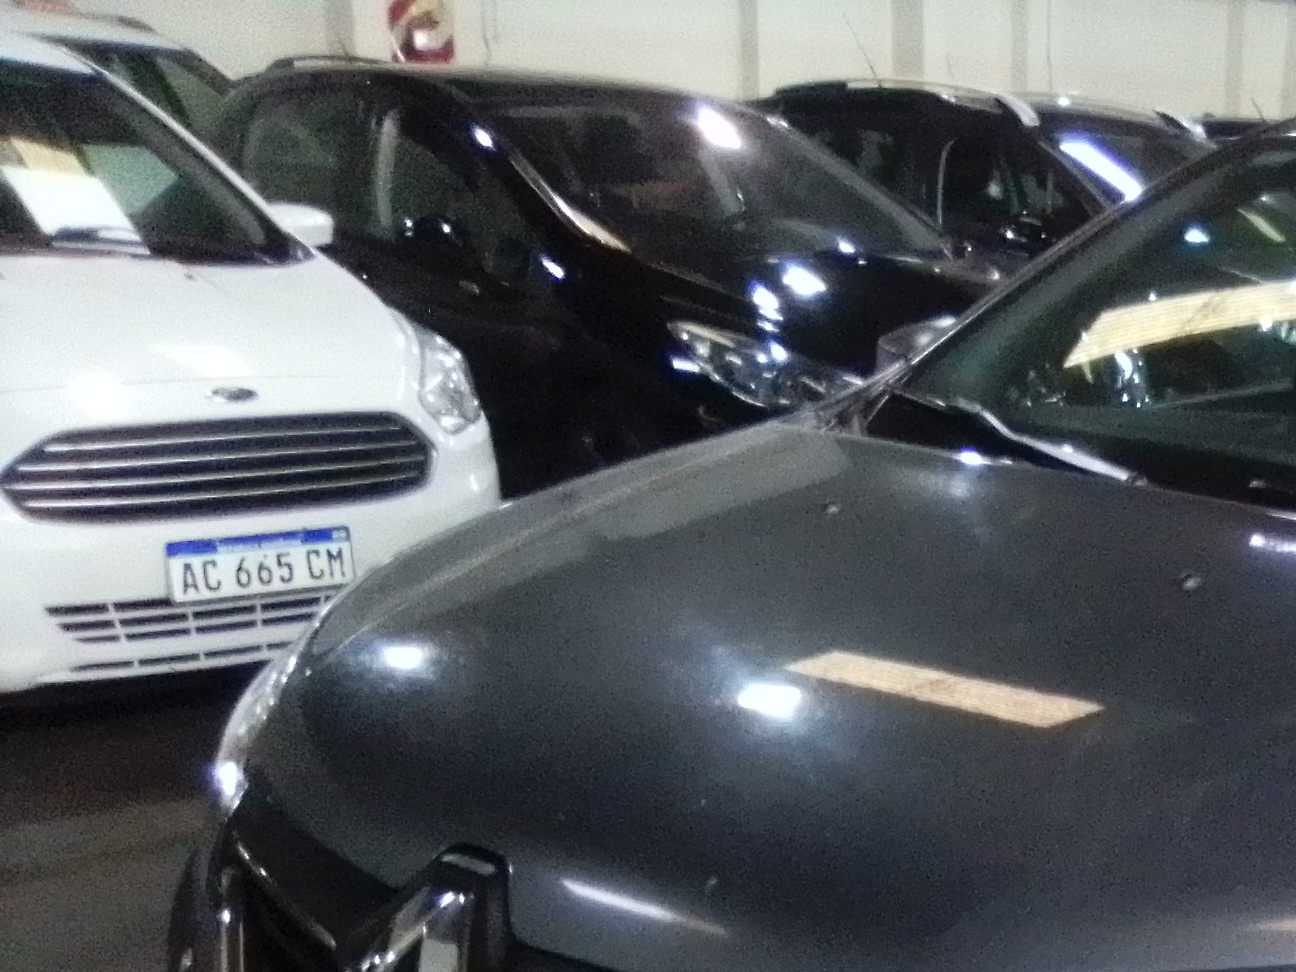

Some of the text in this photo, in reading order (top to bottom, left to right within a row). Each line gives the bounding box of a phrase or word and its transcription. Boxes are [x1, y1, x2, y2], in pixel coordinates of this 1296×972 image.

[183, 547, 346, 595] AC 665 CM
